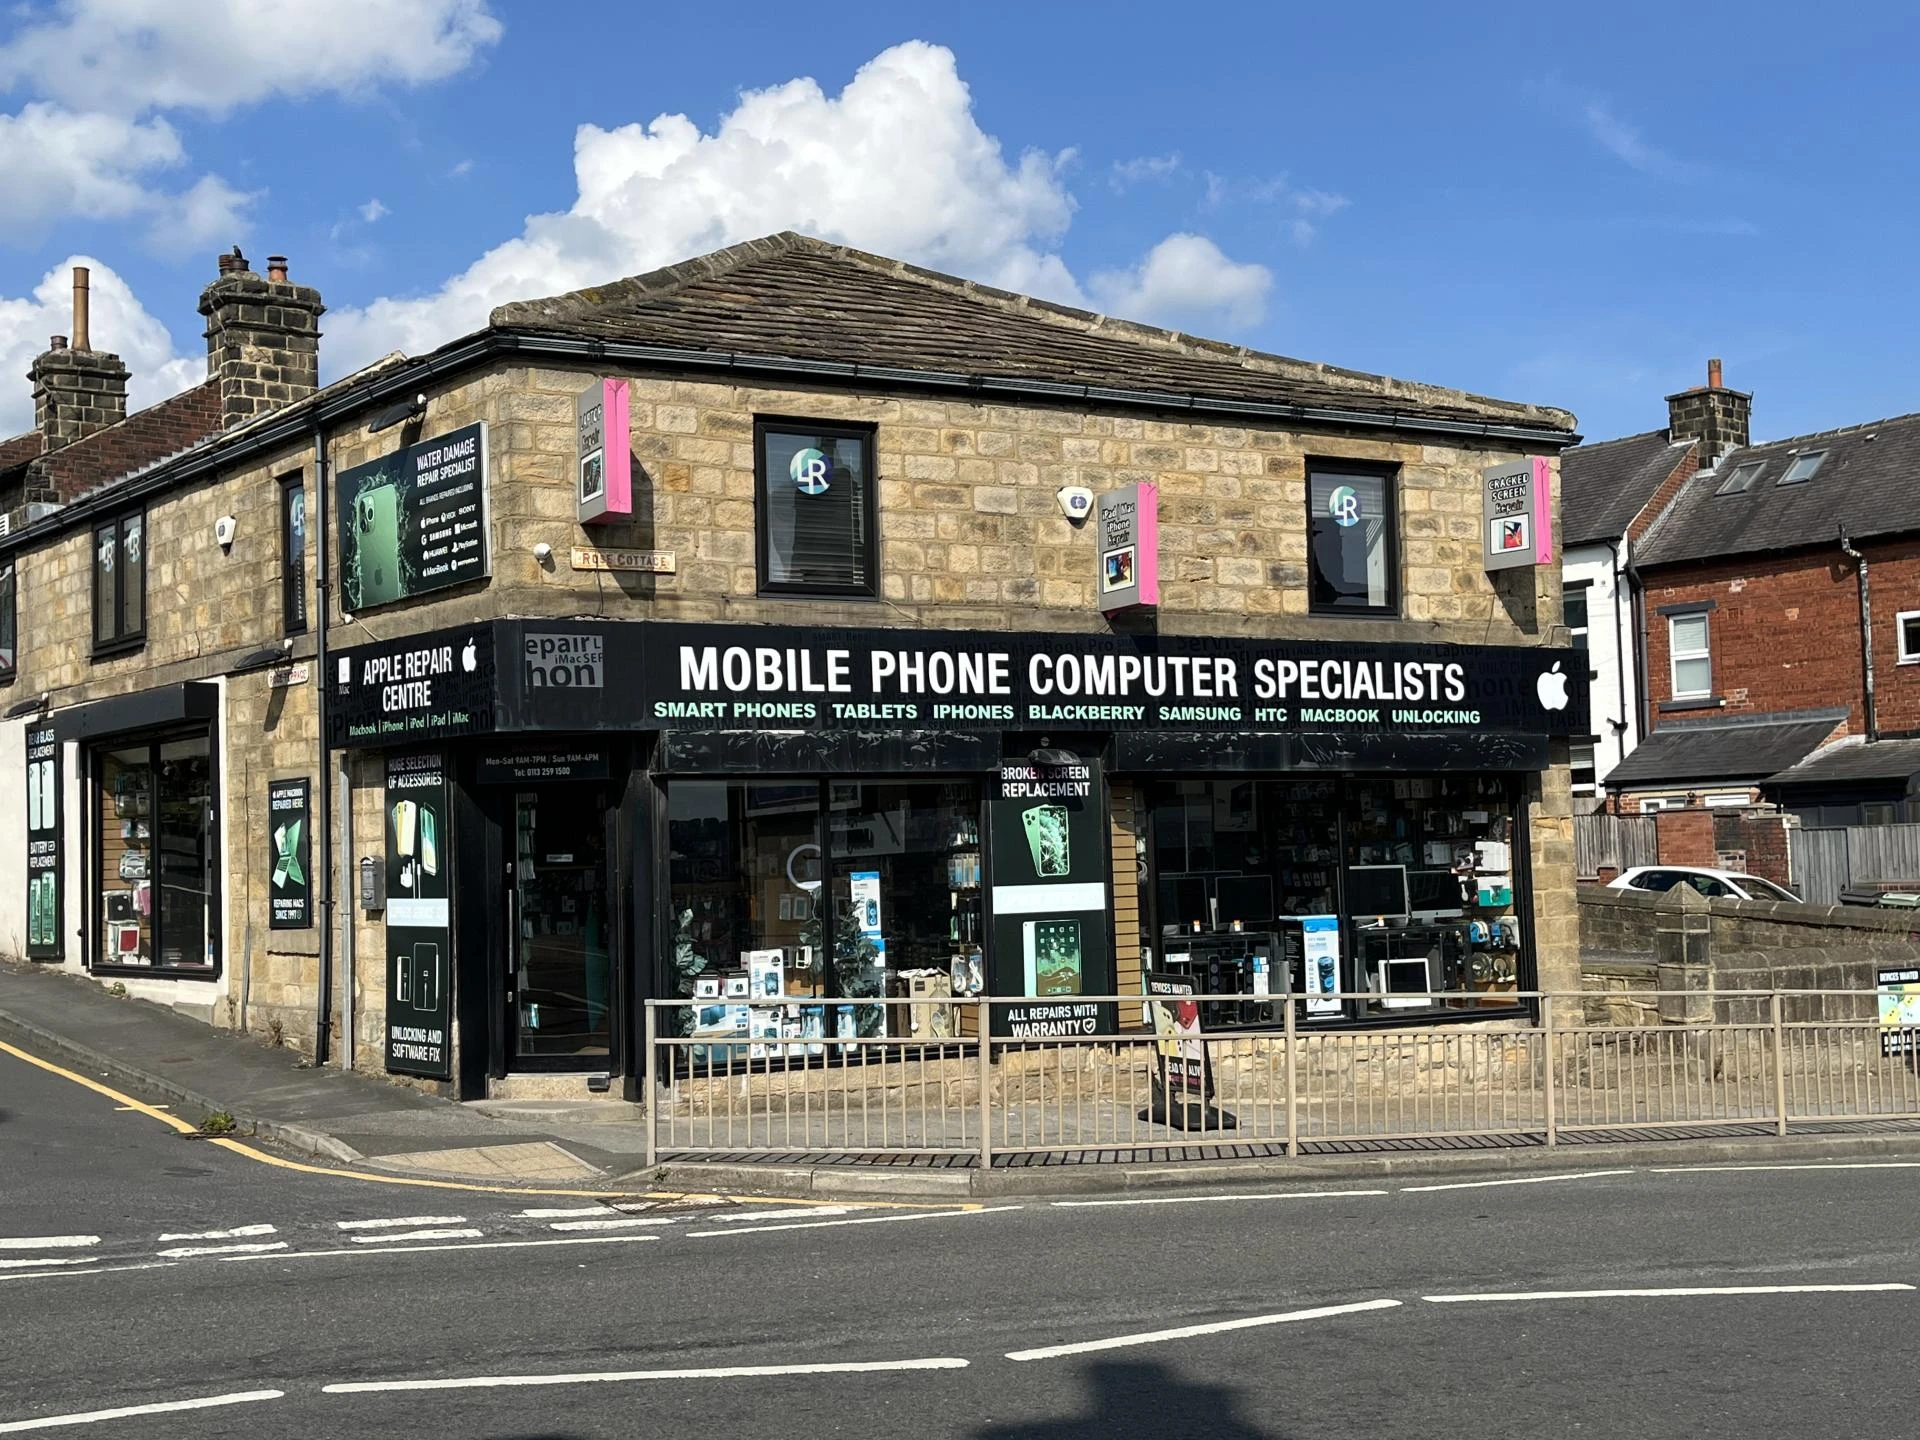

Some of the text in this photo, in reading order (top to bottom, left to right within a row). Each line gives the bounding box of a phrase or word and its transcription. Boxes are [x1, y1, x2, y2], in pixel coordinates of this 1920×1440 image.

[416, 437, 475, 471] WATER DAMAGE
[416, 456, 476, 488] REPAIR SPECIALIST
[1488, 473, 1530, 490] CRACKED
[1492, 485, 1526, 502] SCREEN
[458, 503, 476, 515] SONY
[1120, 502, 1135, 516] Mac
[1495, 499, 1524, 515] Repair
[1107, 519, 1130, 534] iPhone
[1107, 530, 1129, 547] Repair
[617, 552, 667, 568] COTTAGE
[427, 563, 449, 576] MacBook
[362, 655, 402, 686] APPLE
[405, 646, 452, 679] REPAIR
[555, 655, 582, 664] iMac
[679, 646, 1466, 702] MOBILE PHONE COMPUTER SPECIALISTS
[382, 680, 432, 712] CENTRE
[654, 702, 1481, 724] SMART PHONES TABLETS IPHONES BLACKBERRY SAMSUNG HTC MACBOOK UNLOCKING
[349, 712, 469, 737] Macbook iPhone iPod iPad iMac
[40, 728, 55, 744] GLASS
[388, 753, 442, 772] HUGE SELECTION
[388, 771, 442, 789] OF ACCESSORIES
[541, 767, 554, 776] 259
[1001, 766, 1090, 780] BROKEN SCREEN
[1001, 781, 1090, 798] REPLACEMENT
[272, 797, 304, 810] REPAIRED HERE
[30, 840, 48, 855] BATTERY
[292, 898, 304, 908] MACS
[275, 909, 288, 920] SINCE
[1151, 981, 1193, 996] DEVICES WANTED
[1007, 1003, 1098, 1022] ALL REPAIRS WITH
[391, 1025, 442, 1045] UNLOCKING AND
[1011, 1020, 1081, 1038] WARRANTY
[392, 1042, 441, 1063] SOFTWARE FIX
